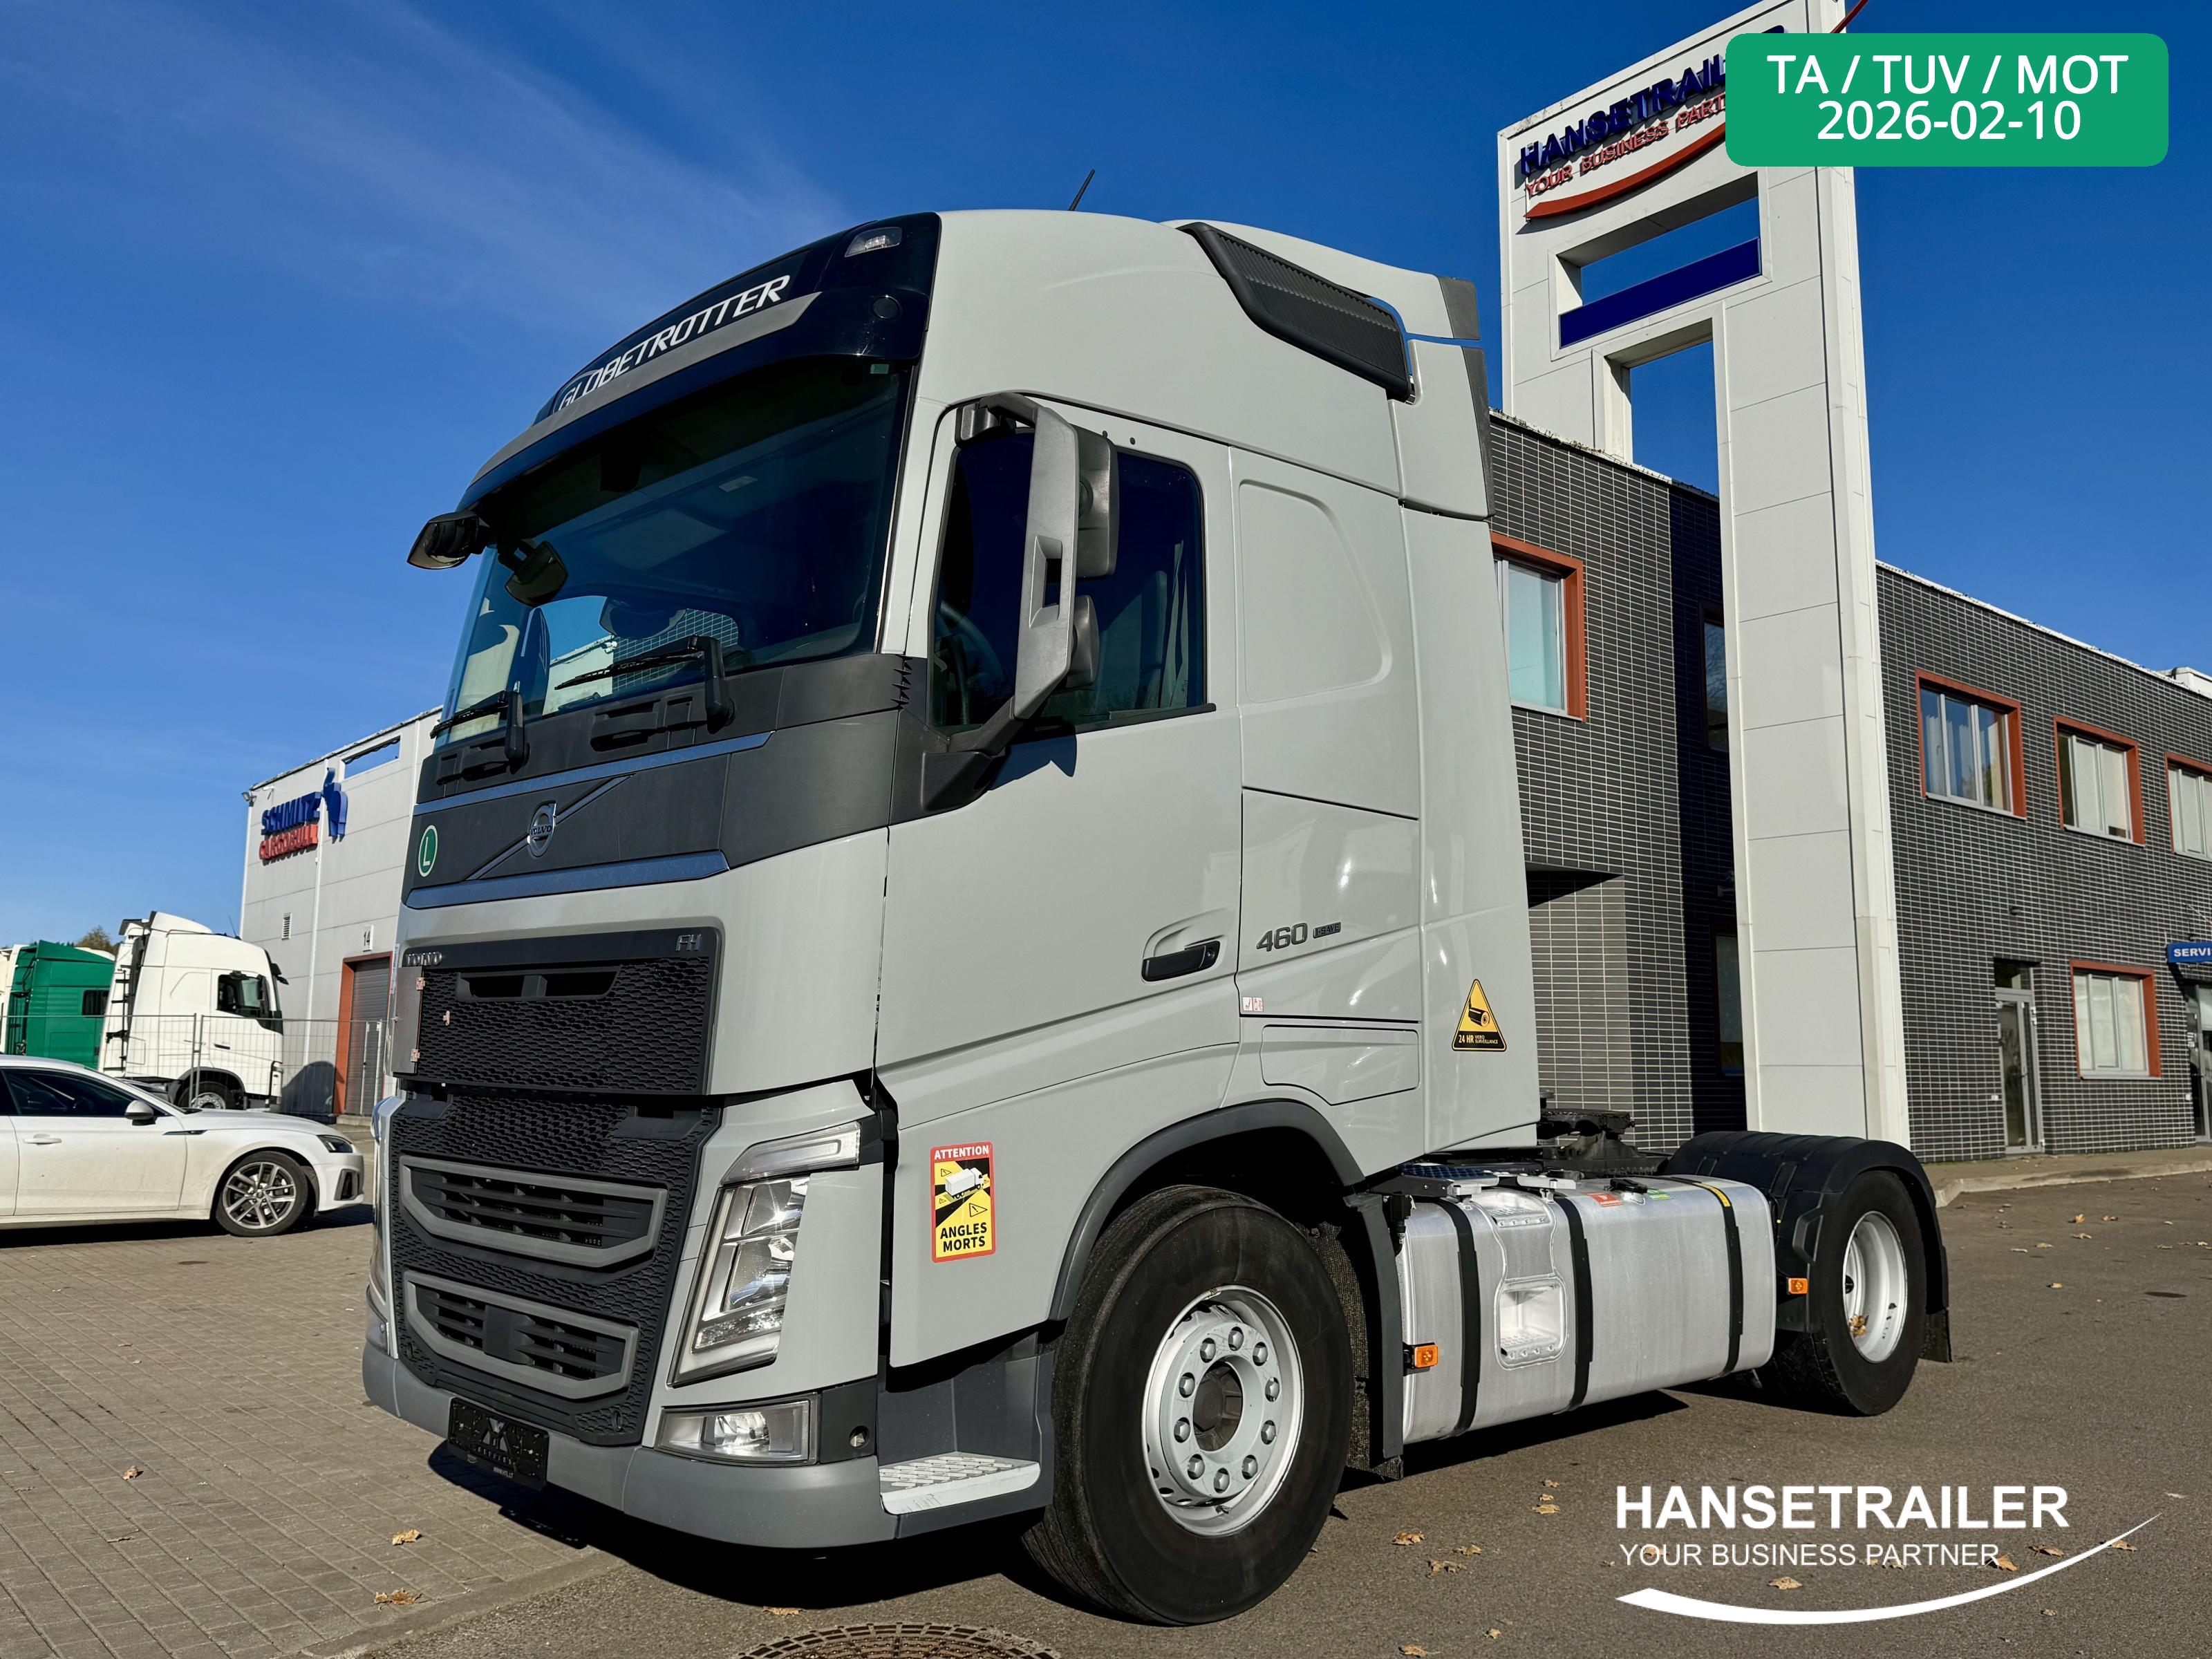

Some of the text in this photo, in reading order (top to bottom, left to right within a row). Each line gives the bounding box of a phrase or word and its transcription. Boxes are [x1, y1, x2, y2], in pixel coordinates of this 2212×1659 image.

[1519, 25, 1785, 176] HANSETRAIL
[1526, 92, 1726, 196] YOUR BUSINESS PART
[558, 274, 790, 411] GLOBETROTTER
[261, 791, 321, 835] SCHMITZ
[259, 823, 319, 860] CARGOBULL
[531, 825, 552, 835] VOLVO
[422, 836, 431, 866] L
[675, 934, 702, 951] FH
[1256, 922, 1340, 952] 460 I-SAVE
[2173, 947, 2212, 957] SERVI
[1459, 1034, 1474, 1044] 24 HR
[934, 1145, 989, 1160] ATTENTION
[940, 1222, 987, 1239] ANGLES
[943, 1235, 986, 1252] MORTS
